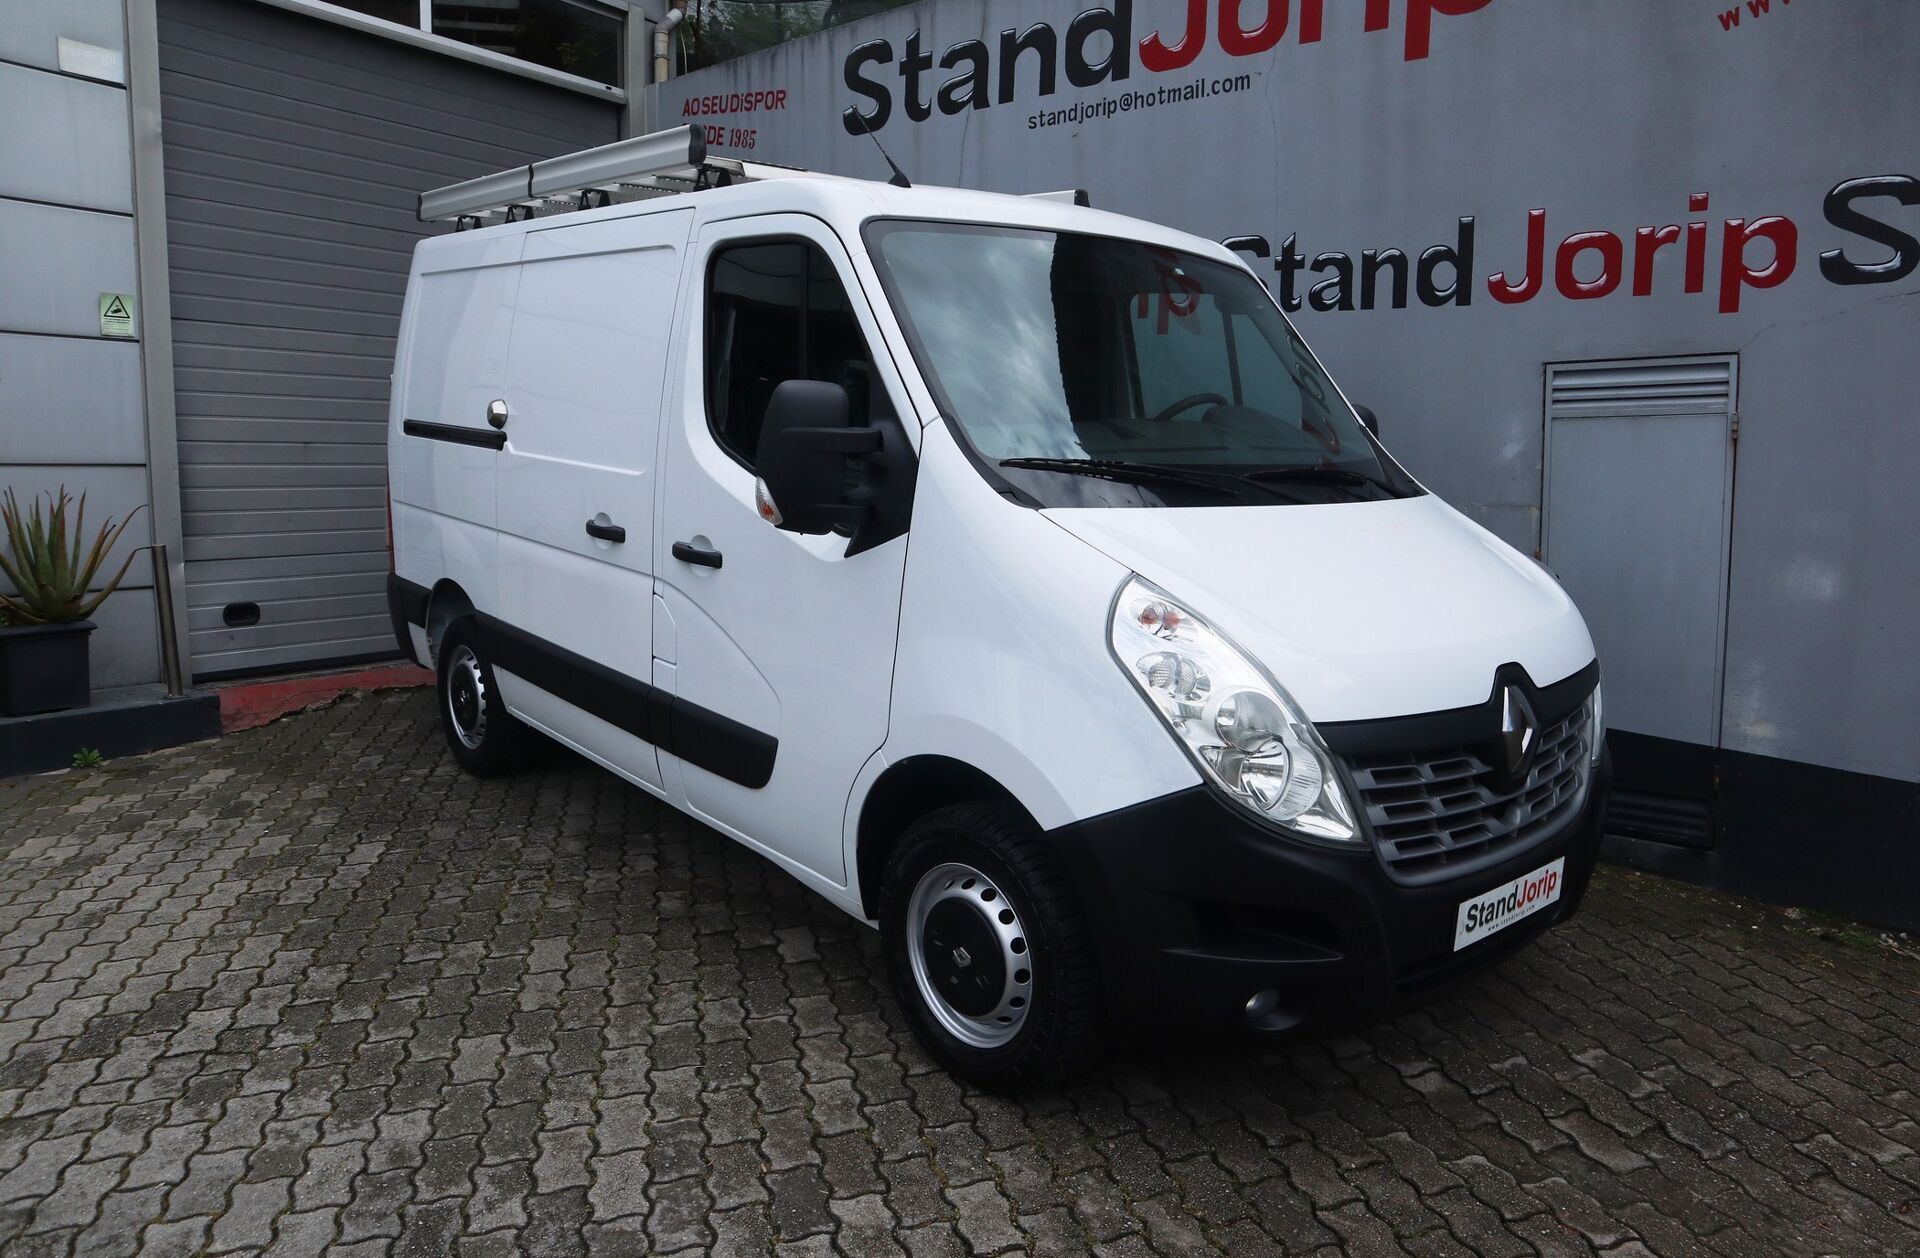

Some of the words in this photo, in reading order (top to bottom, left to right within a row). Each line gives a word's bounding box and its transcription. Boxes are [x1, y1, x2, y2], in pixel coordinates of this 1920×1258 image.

[842, 0, 1496, 137] StandJo
[1027, 73, 1251, 130] standjorip@hotmail.com
[729, 127, 757, 150] 1985
